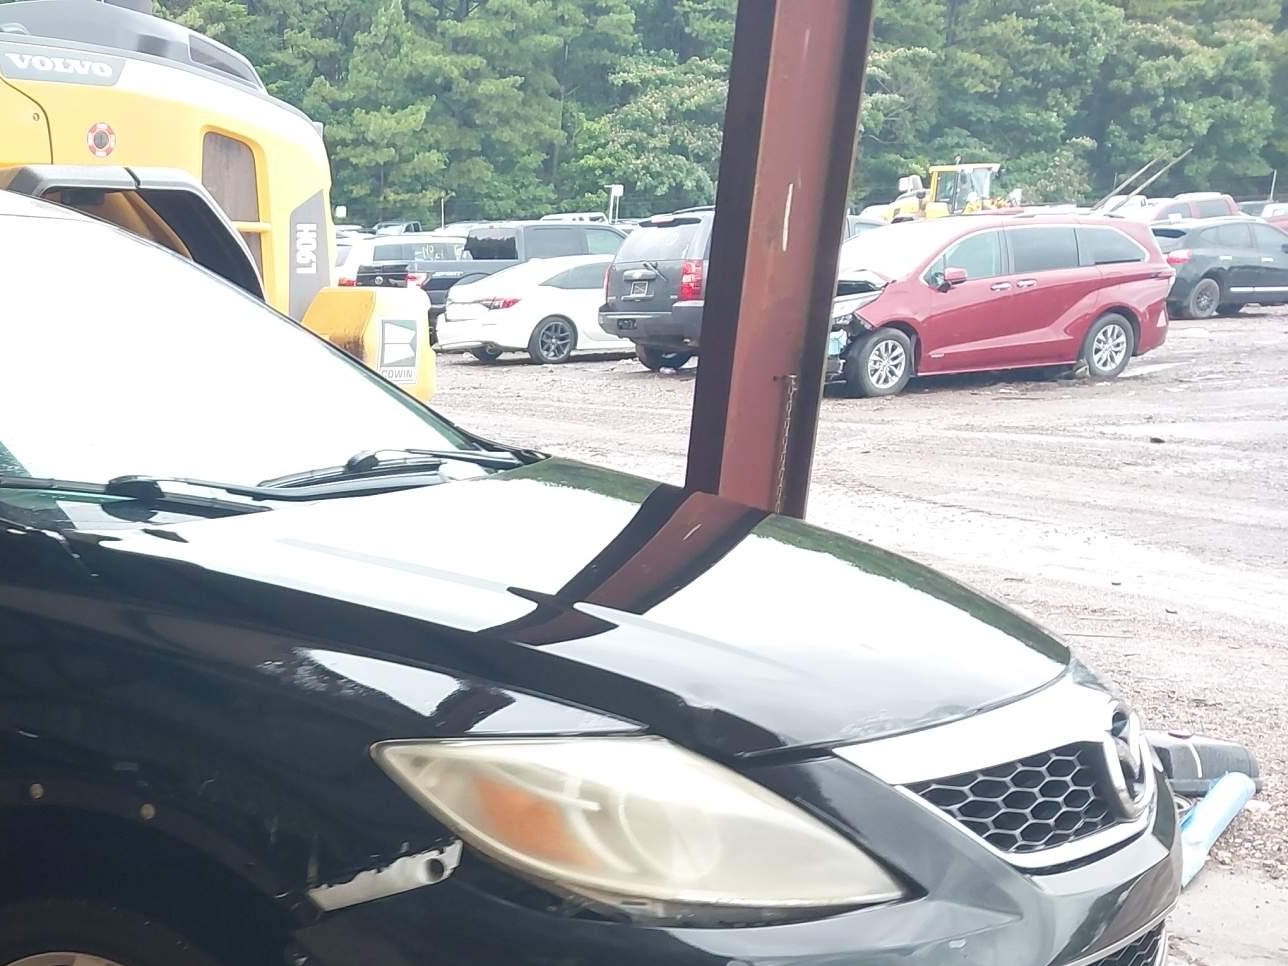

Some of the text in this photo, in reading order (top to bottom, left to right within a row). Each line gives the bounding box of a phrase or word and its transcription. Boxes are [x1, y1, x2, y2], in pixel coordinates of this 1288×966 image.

[4, 53, 113, 77] VOLVO
[295, 223, 318, 274] L90H
[381, 368, 413, 379] COWIN
